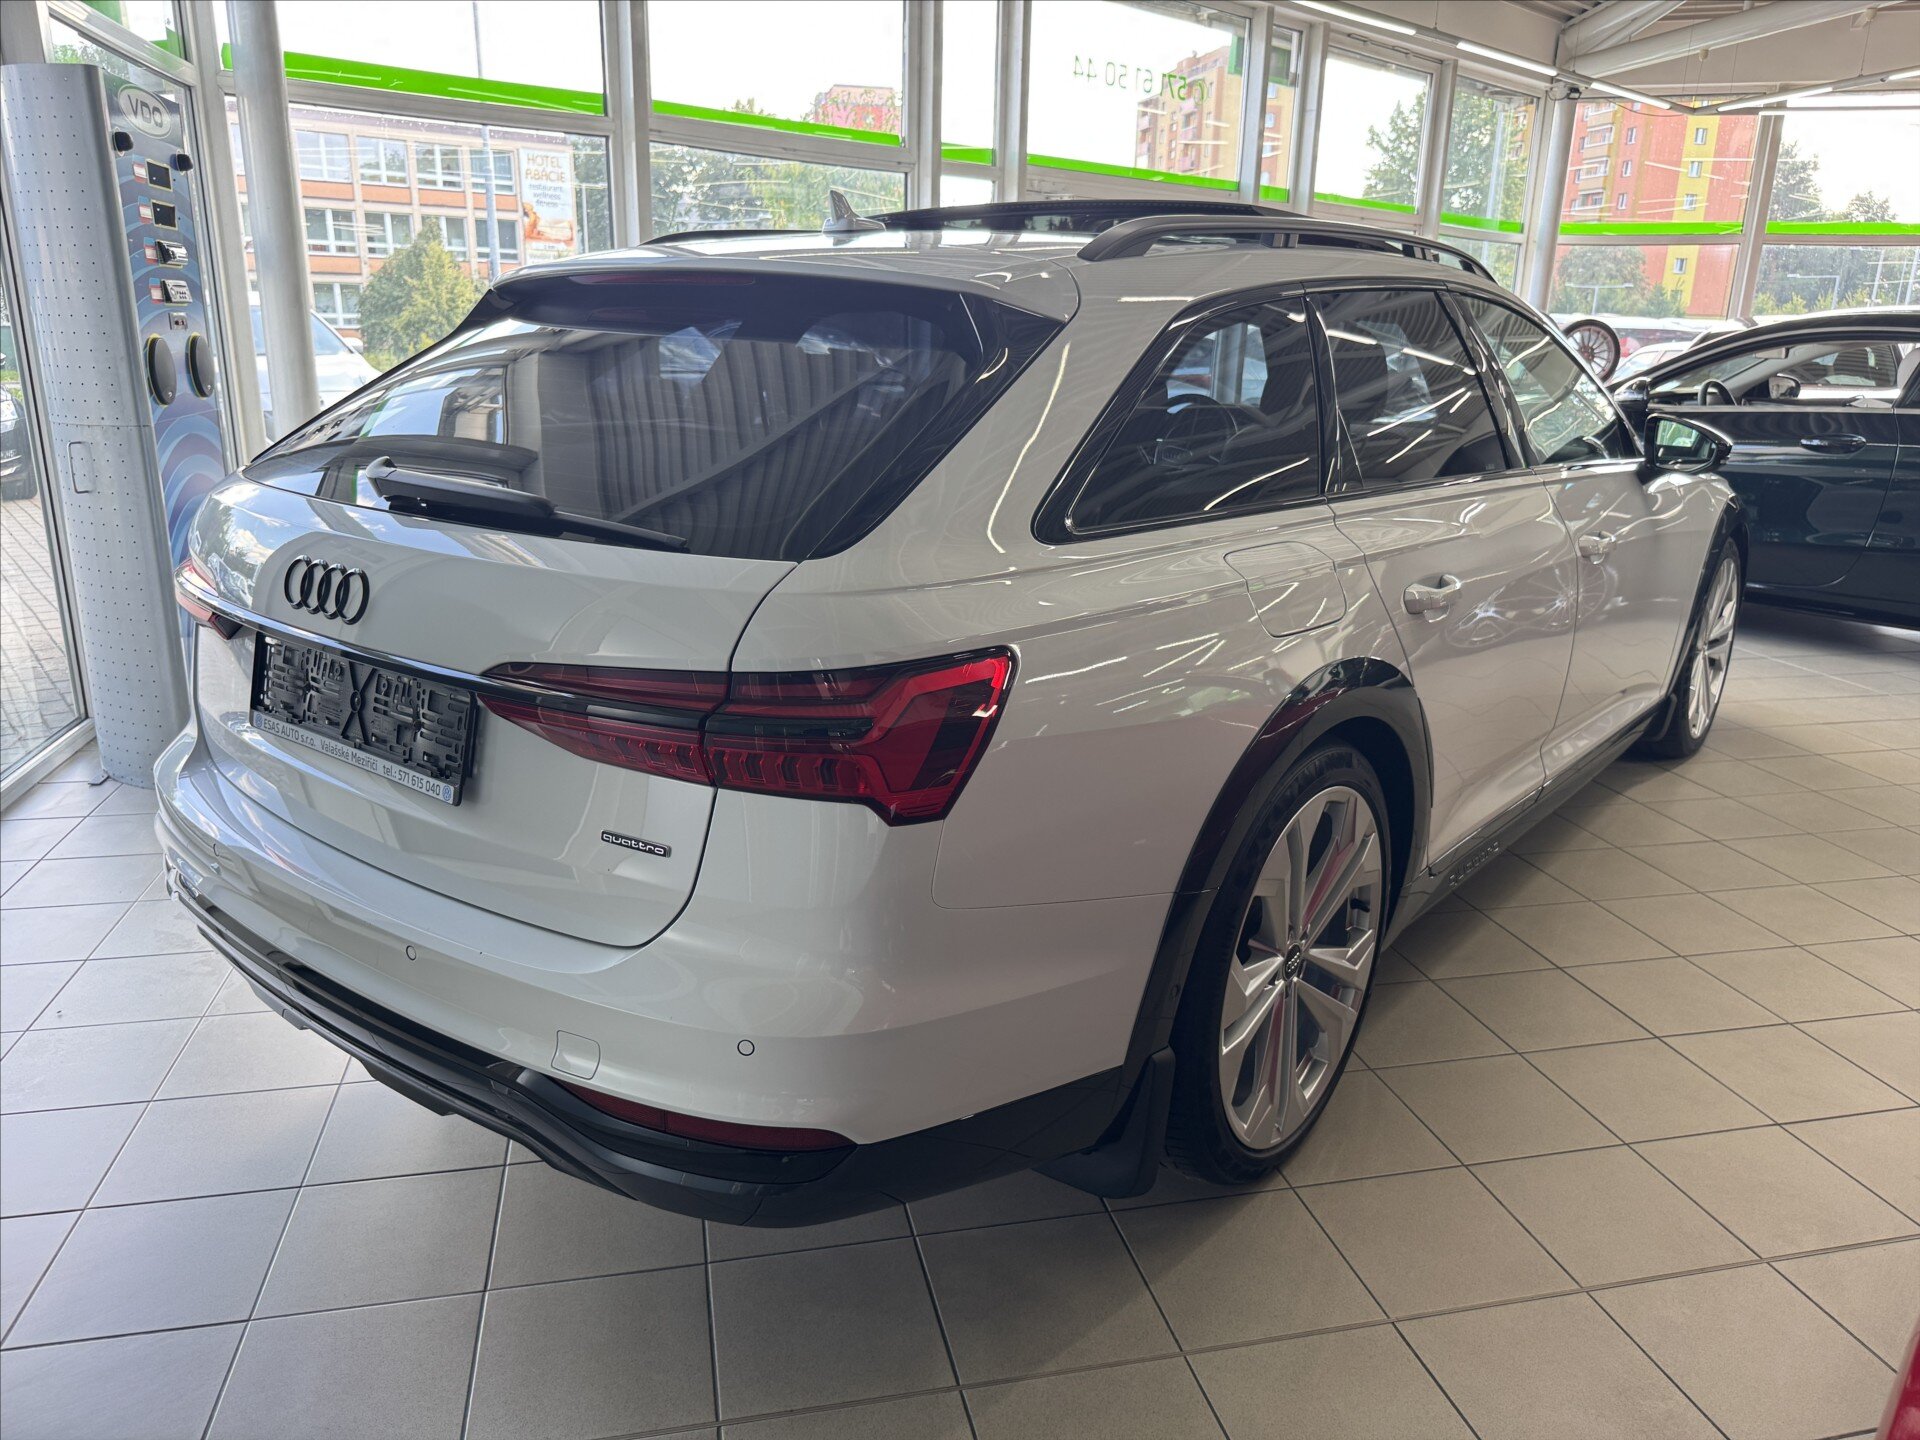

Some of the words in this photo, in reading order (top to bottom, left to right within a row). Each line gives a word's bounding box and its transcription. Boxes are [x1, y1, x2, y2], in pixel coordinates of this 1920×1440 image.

[127, 93, 164, 128] VDO
[526, 153, 563, 169] HOTEL
[263, 718, 280, 734] ESAS
[281, 725, 300, 741] AUTO
[301, 734, 316, 748] s.r.o.
[320, 739, 350, 761] Valašské
[351, 750, 378, 771] Meziříčí
[382, 764, 397, 778] tel.:
[398, 769, 410, 784] 571
[411, 774, 424, 790] 615
[425, 780, 441, 797] 040
[602, 833, 665, 855] quattro
